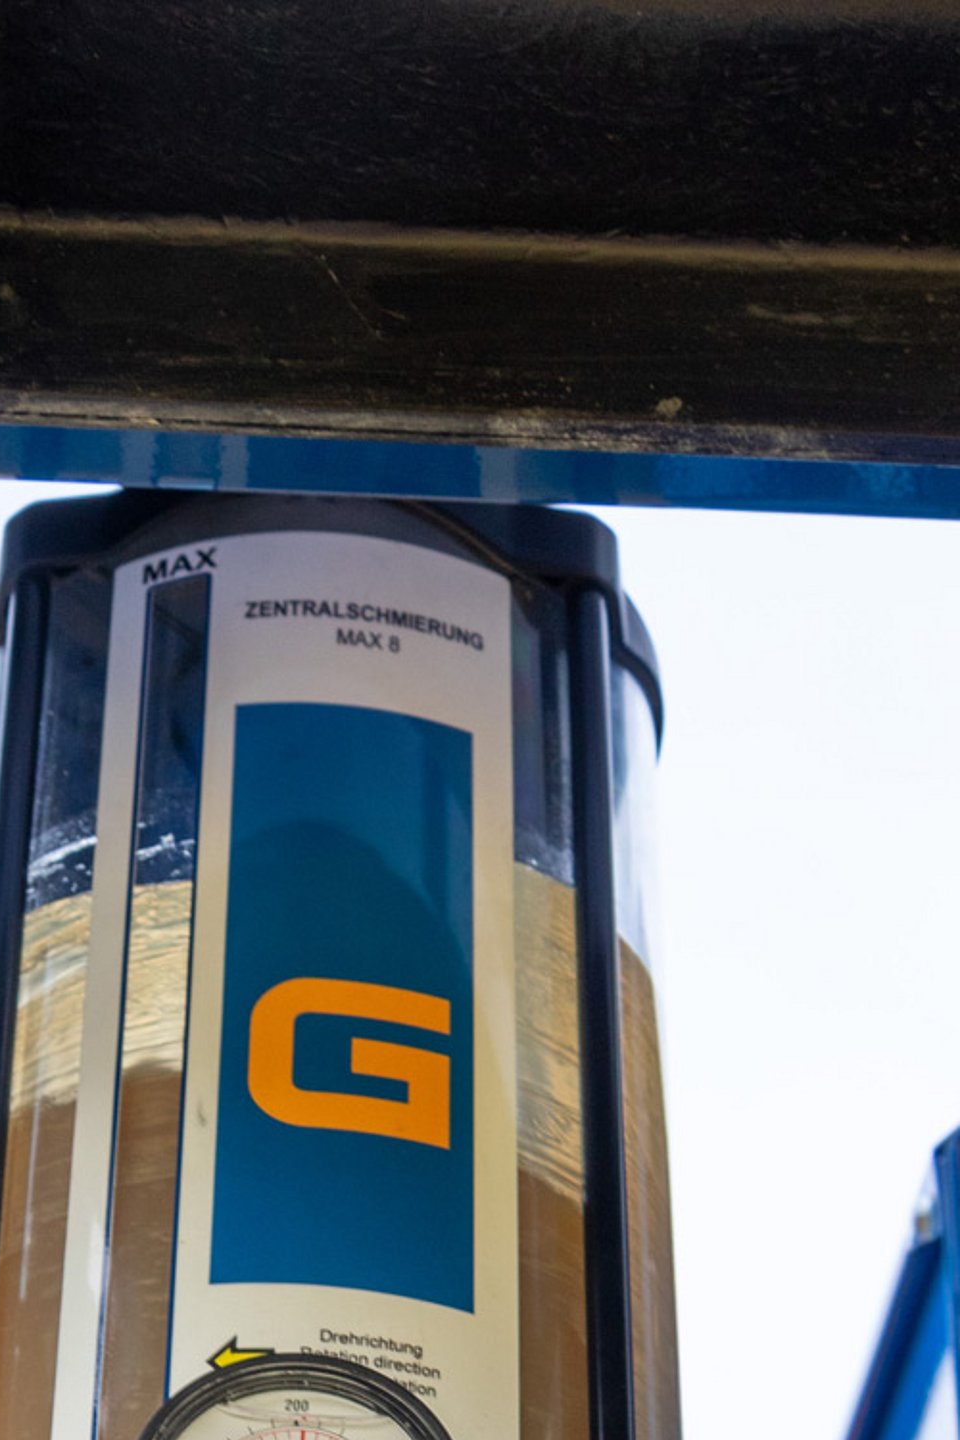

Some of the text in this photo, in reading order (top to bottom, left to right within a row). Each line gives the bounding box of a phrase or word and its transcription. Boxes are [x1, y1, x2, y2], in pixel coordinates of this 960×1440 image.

[142, 547, 218, 585] MAX
[244, 599, 485, 651] ZENTRALSCHMIERUNG
[336, 628, 401, 654] MAX 8
[247, 976, 451, 1150] G
[320, 1328, 423, 1359] Drehrichtung
[373, 1354, 441, 1380] direction
[284, 1399, 309, 1412] 200
